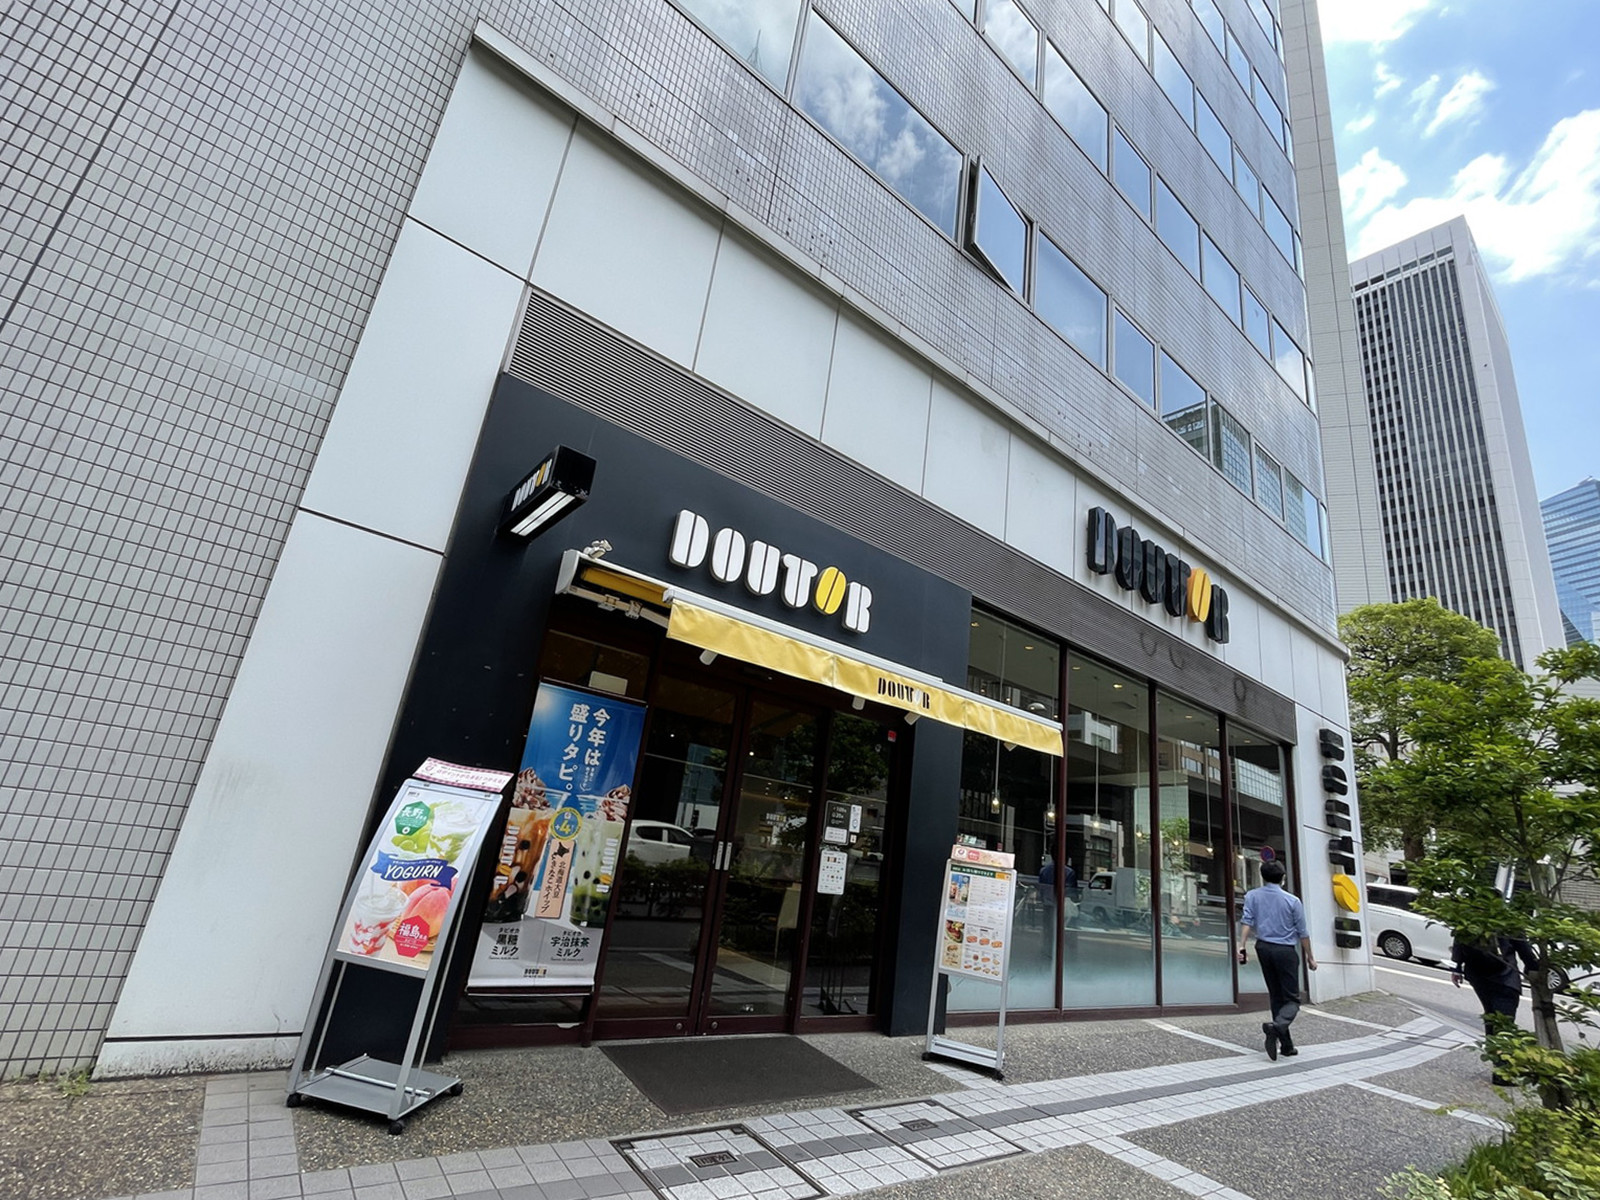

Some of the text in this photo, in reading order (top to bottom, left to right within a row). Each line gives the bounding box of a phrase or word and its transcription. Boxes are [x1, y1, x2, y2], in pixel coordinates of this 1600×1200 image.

[669, 509, 873, 634] DOUTOR
[1087, 506, 1230, 644] DOUTOR
[877, 677, 930, 709] DOUTOR
[558, 703, 590, 791] 盛りタピ。
[583, 708, 611, 766] 今年は
[384, 864, 443, 879] YOGURN
[491, 945, 519, 956] ミルク
[550, 936, 590, 948] 宇治抹茶
[556, 947, 581, 957] ミルク
